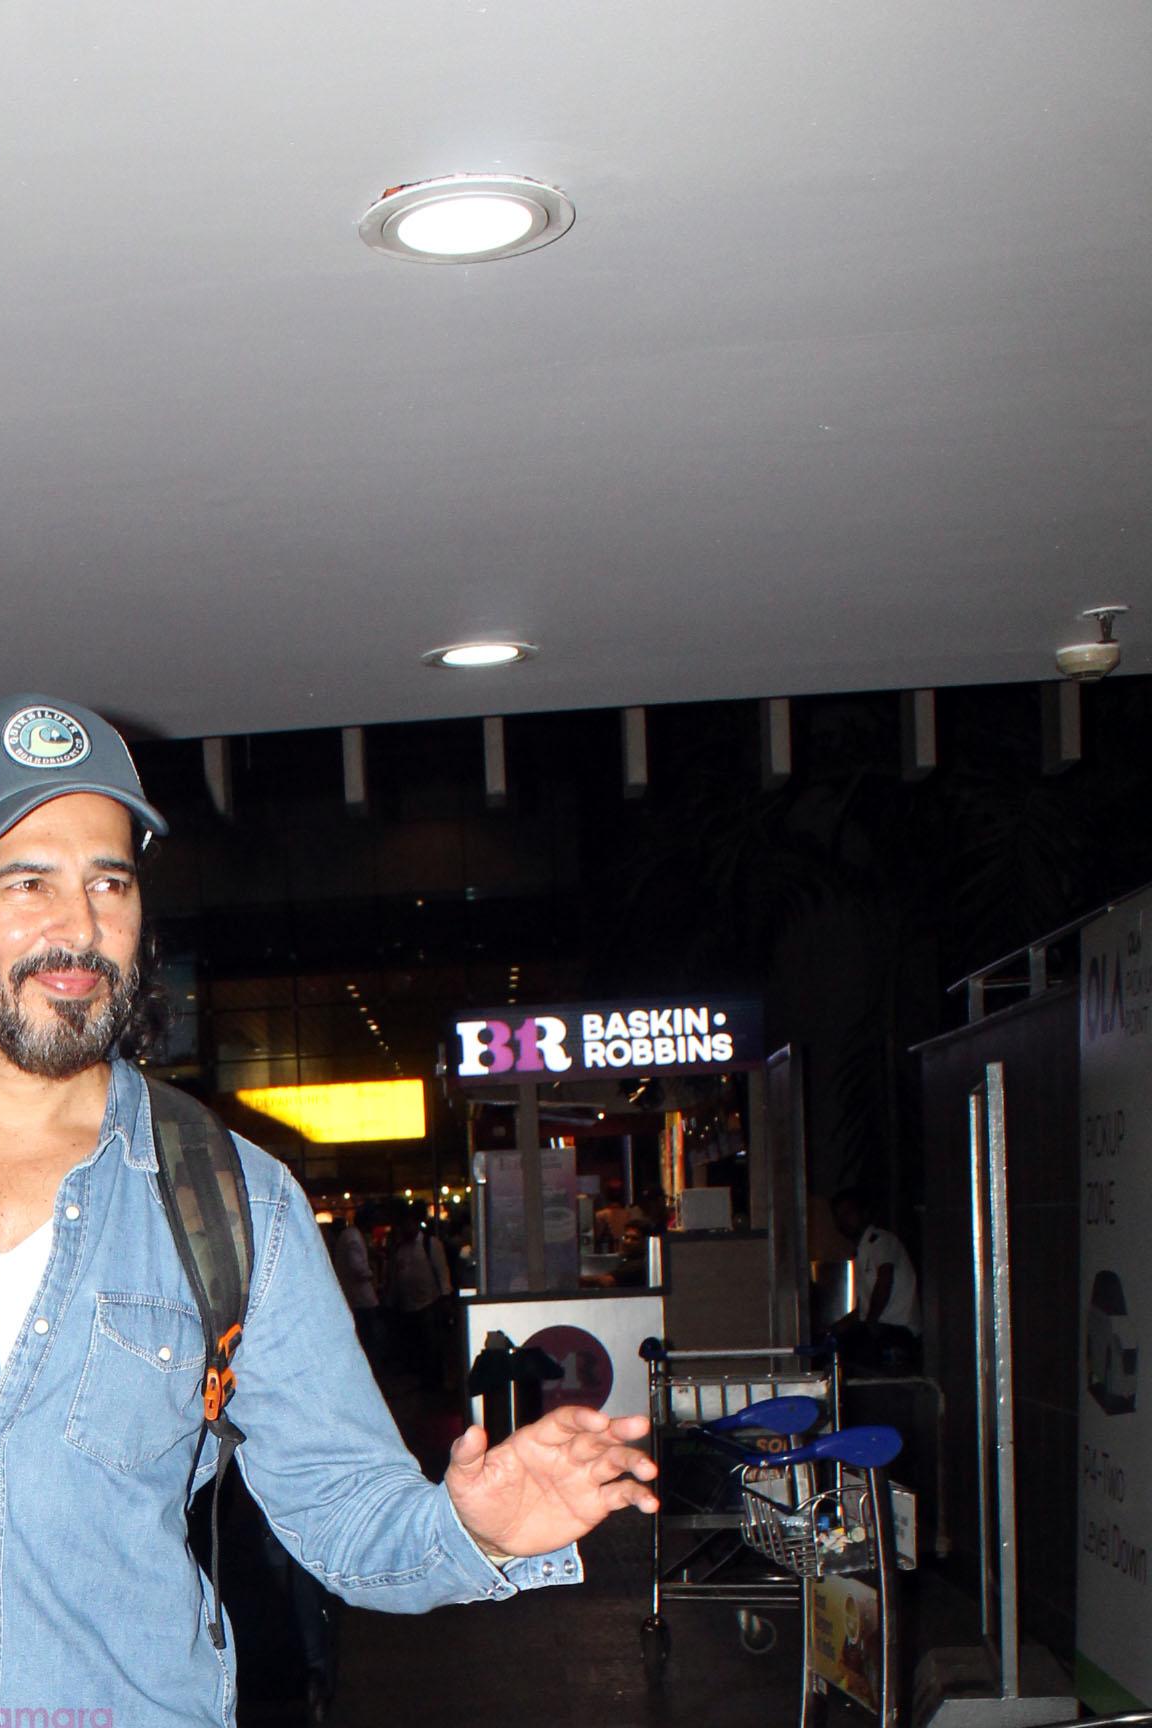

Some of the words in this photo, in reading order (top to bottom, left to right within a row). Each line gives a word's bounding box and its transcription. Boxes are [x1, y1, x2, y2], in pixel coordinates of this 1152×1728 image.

[9, 710, 78, 745] QUIKSILVER
[1087, 954, 1125, 1041] OLA
[583, 1007, 709, 1041] BASKIN
[584, 1033, 733, 1068] ROBBINS
